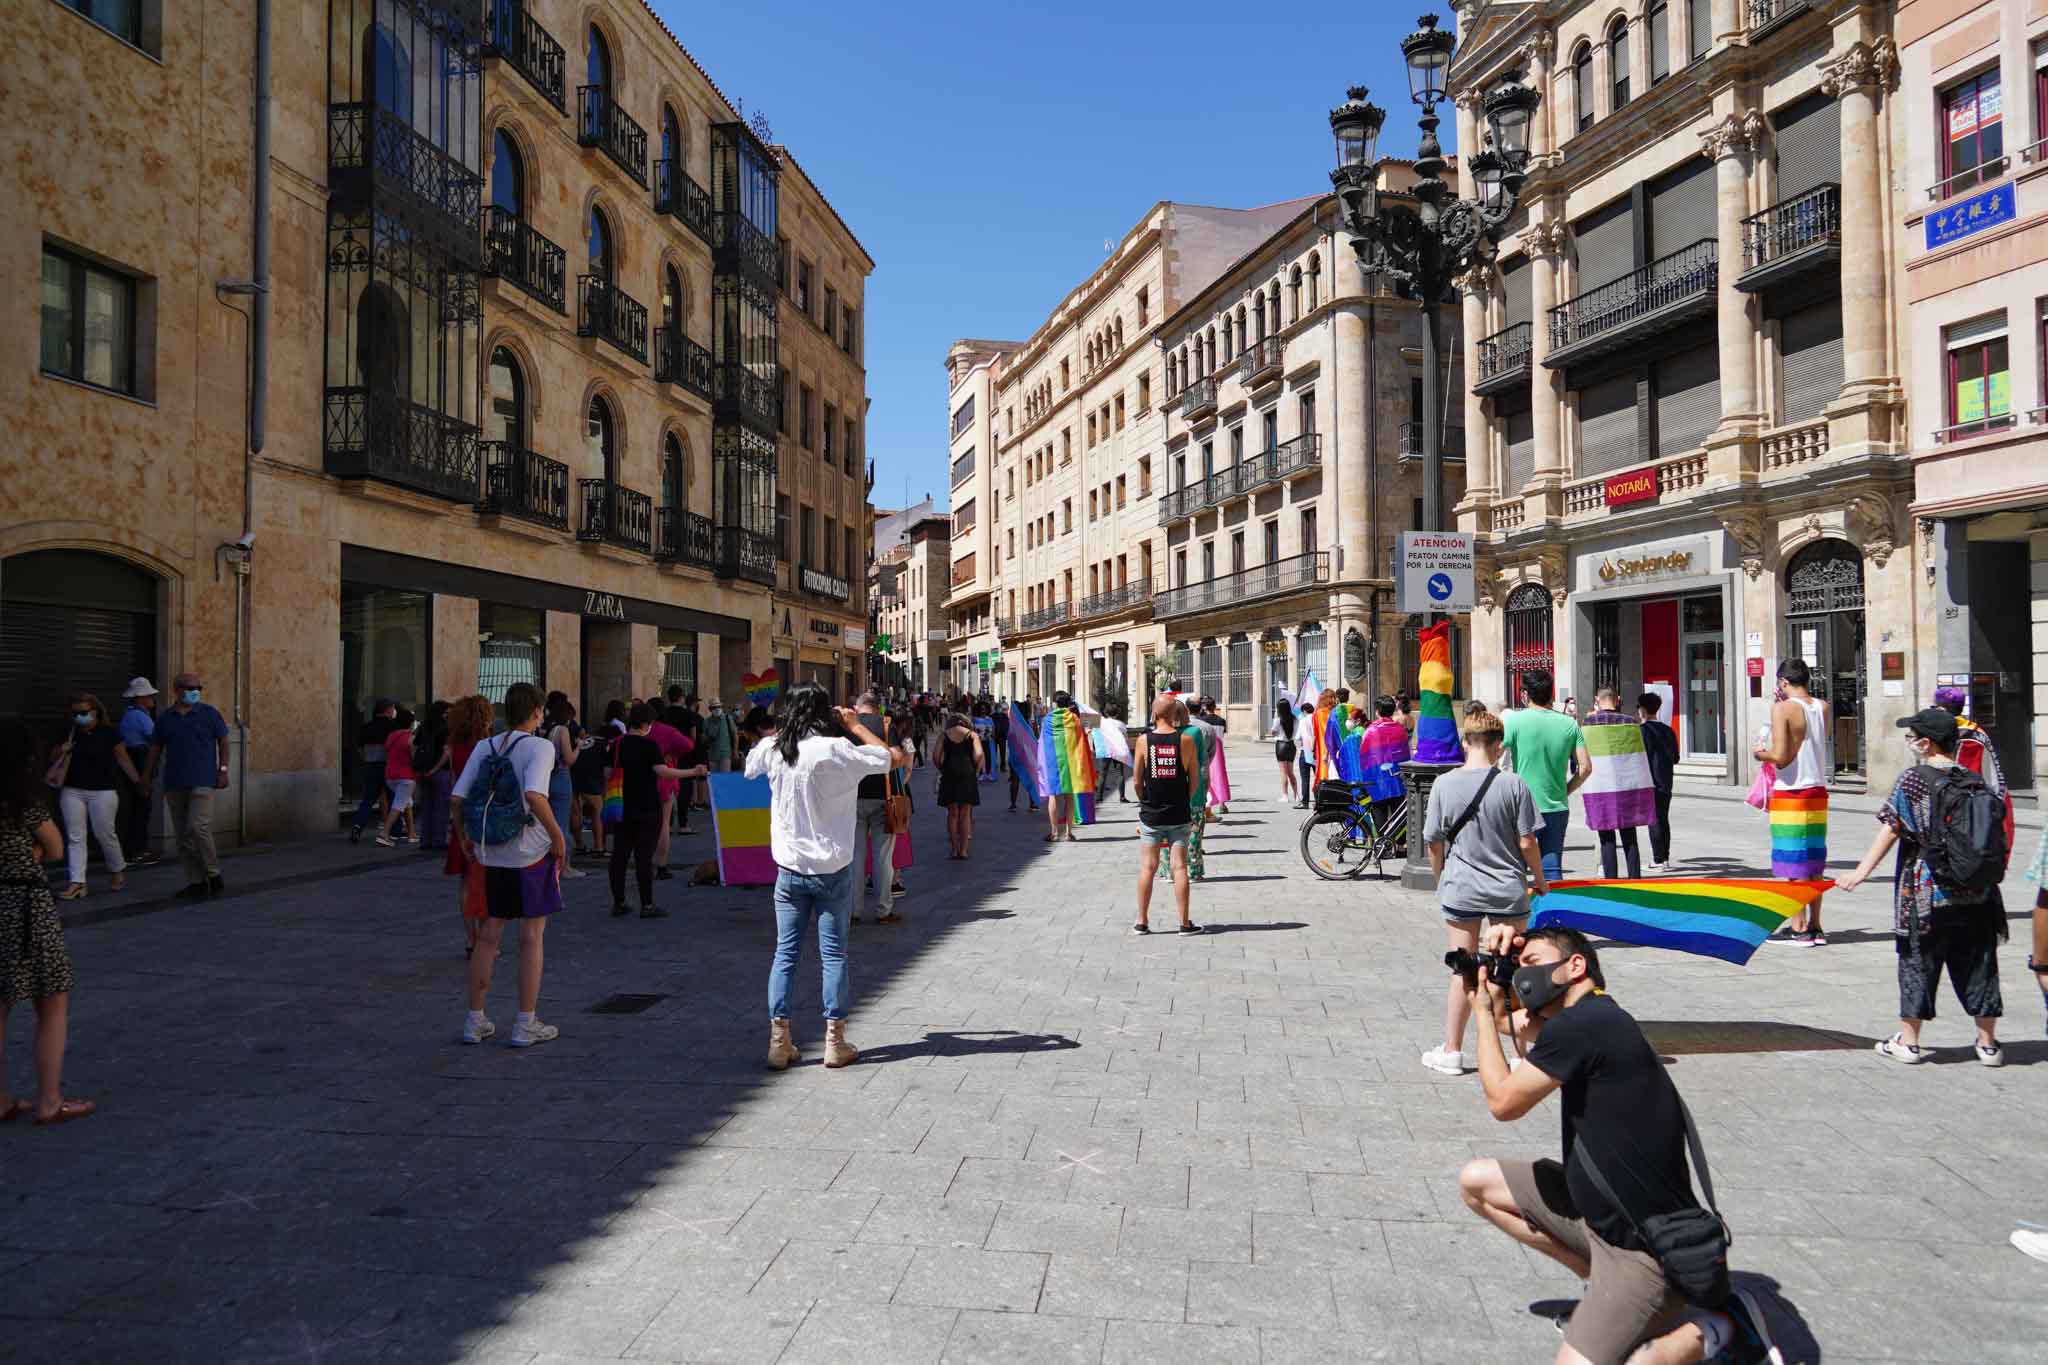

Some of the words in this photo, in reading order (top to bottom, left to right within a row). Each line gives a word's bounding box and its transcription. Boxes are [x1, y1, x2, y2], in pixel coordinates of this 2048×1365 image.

[1608, 476, 1651, 498] NOTARÍA
[1438, 562, 1472, 570] DERECHA
[1616, 550, 1694, 577] Santander
[803, 569, 832, 595] FOTOCOPIAS
[584, 591, 625, 619] ZARA
[1157, 757, 1176, 766] WEST
[1157, 768, 1176, 776] COAST
